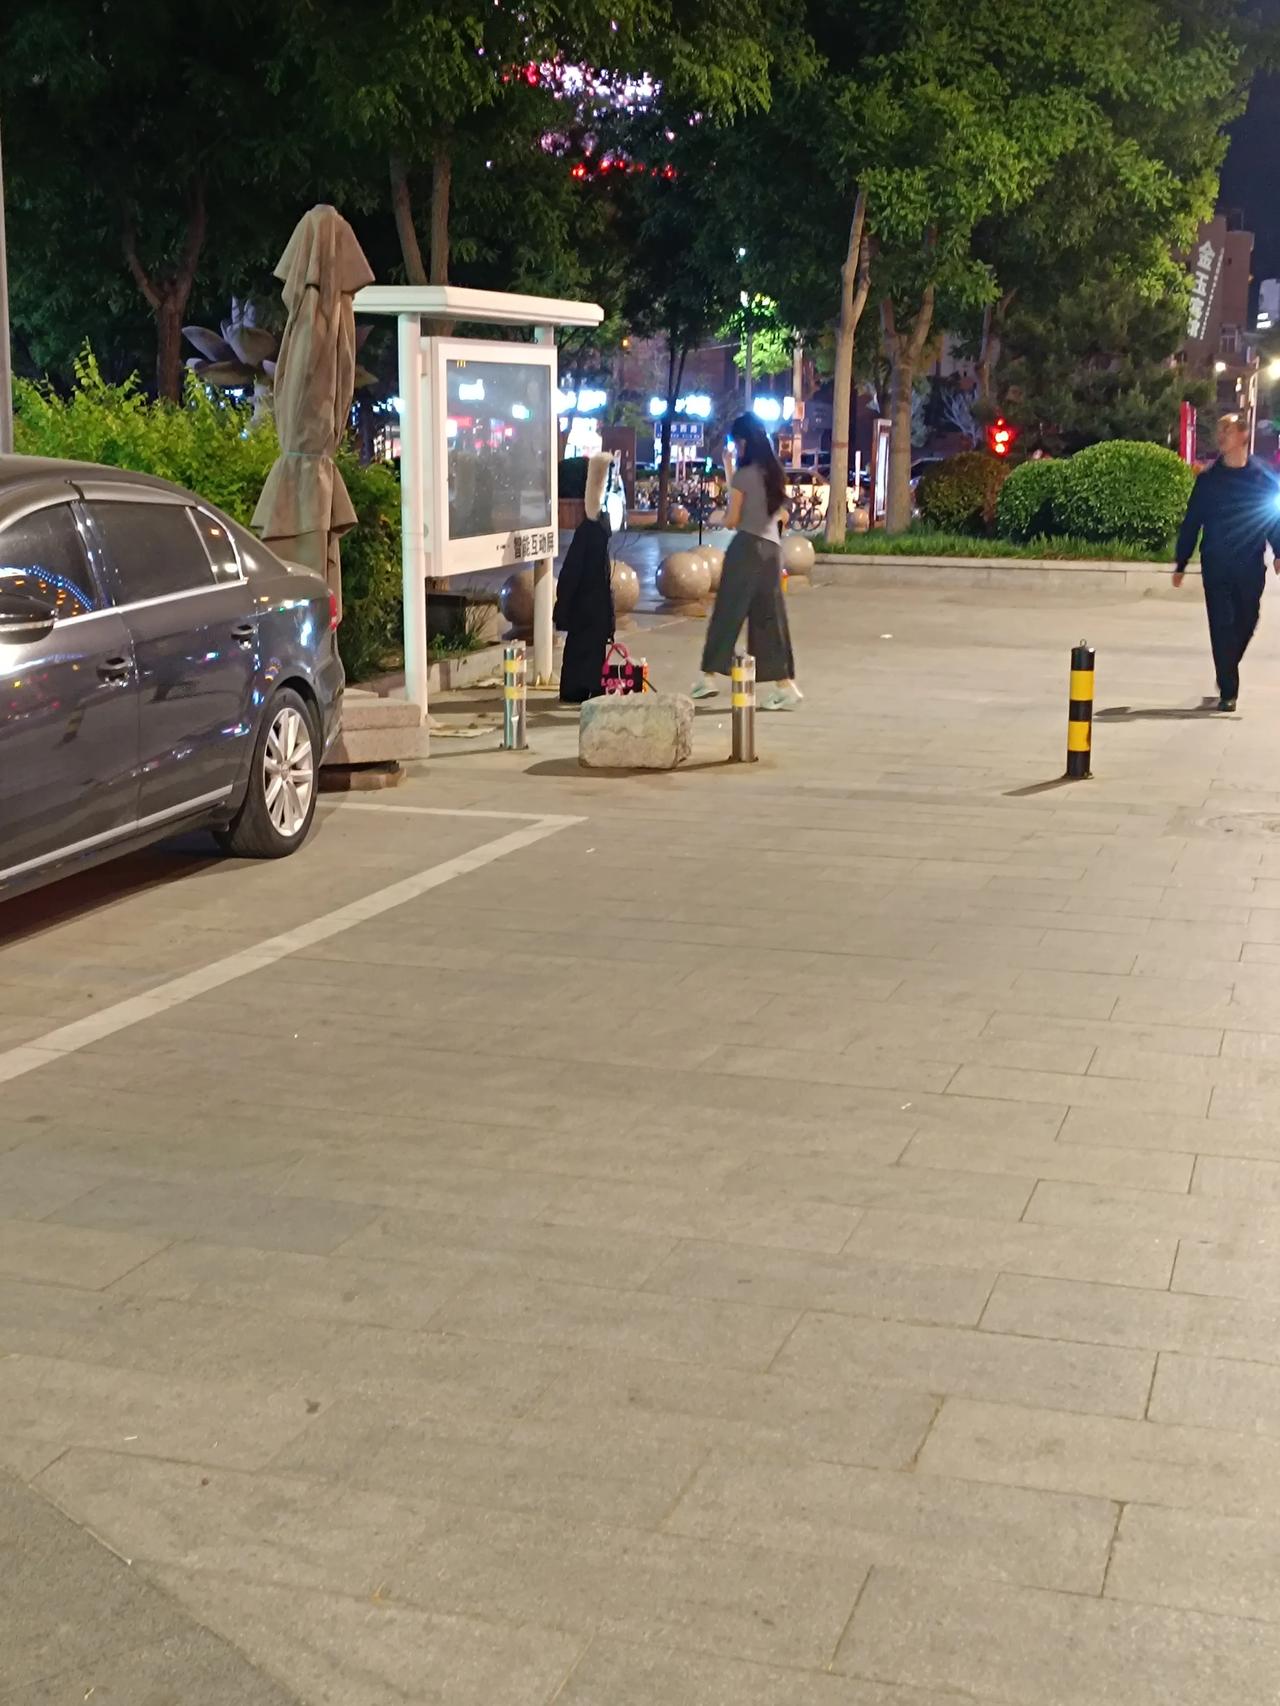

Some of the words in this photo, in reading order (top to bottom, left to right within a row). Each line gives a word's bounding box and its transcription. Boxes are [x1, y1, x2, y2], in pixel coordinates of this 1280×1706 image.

[513, 532, 554, 559] 智能互动屏
